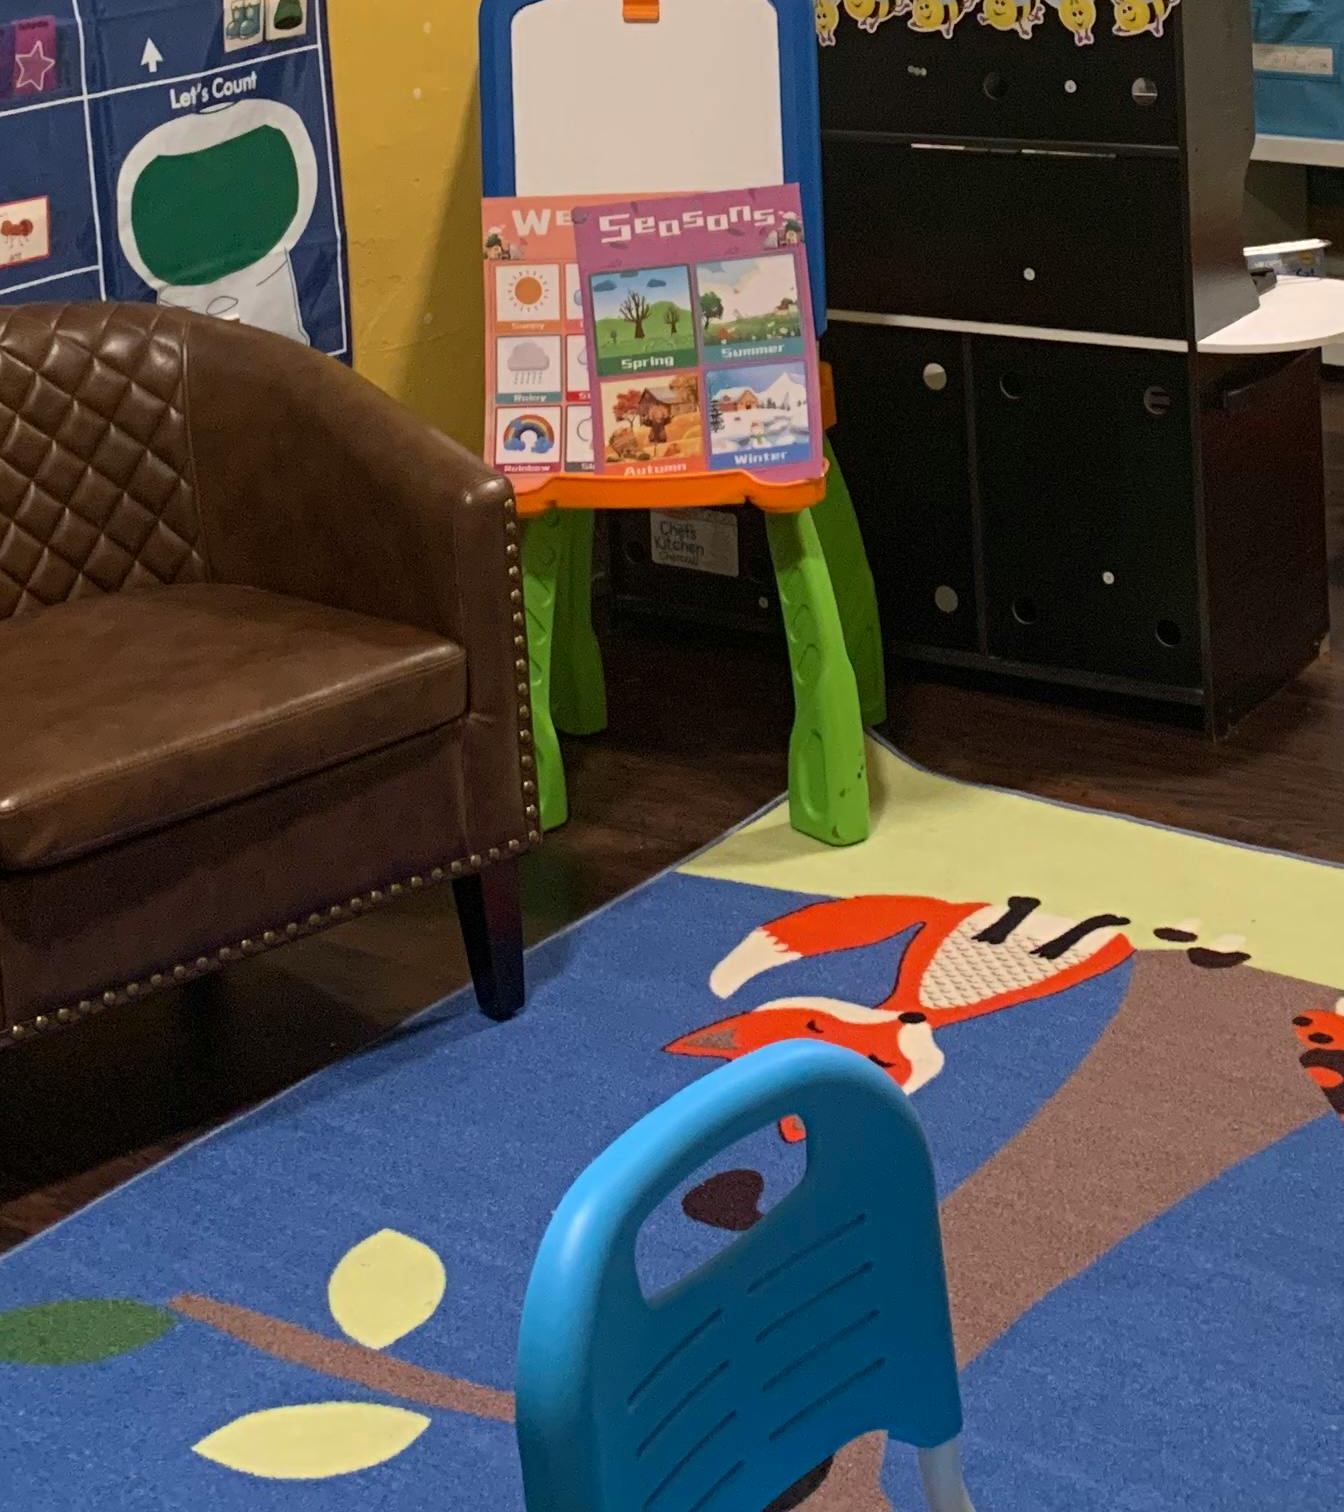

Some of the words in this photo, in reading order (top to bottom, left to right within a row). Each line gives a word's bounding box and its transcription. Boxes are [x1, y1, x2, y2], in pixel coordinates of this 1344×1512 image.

[169, 81, 209, 109] Let's
[212, 71, 257, 97] Count
[599, 205, 775, 243] Seasons
[721, 342, 785, 359] Summer
[621, 355, 675, 371] Spring
[734, 450, 788, 466] Winter
[624, 462, 687, 477] Autumn
